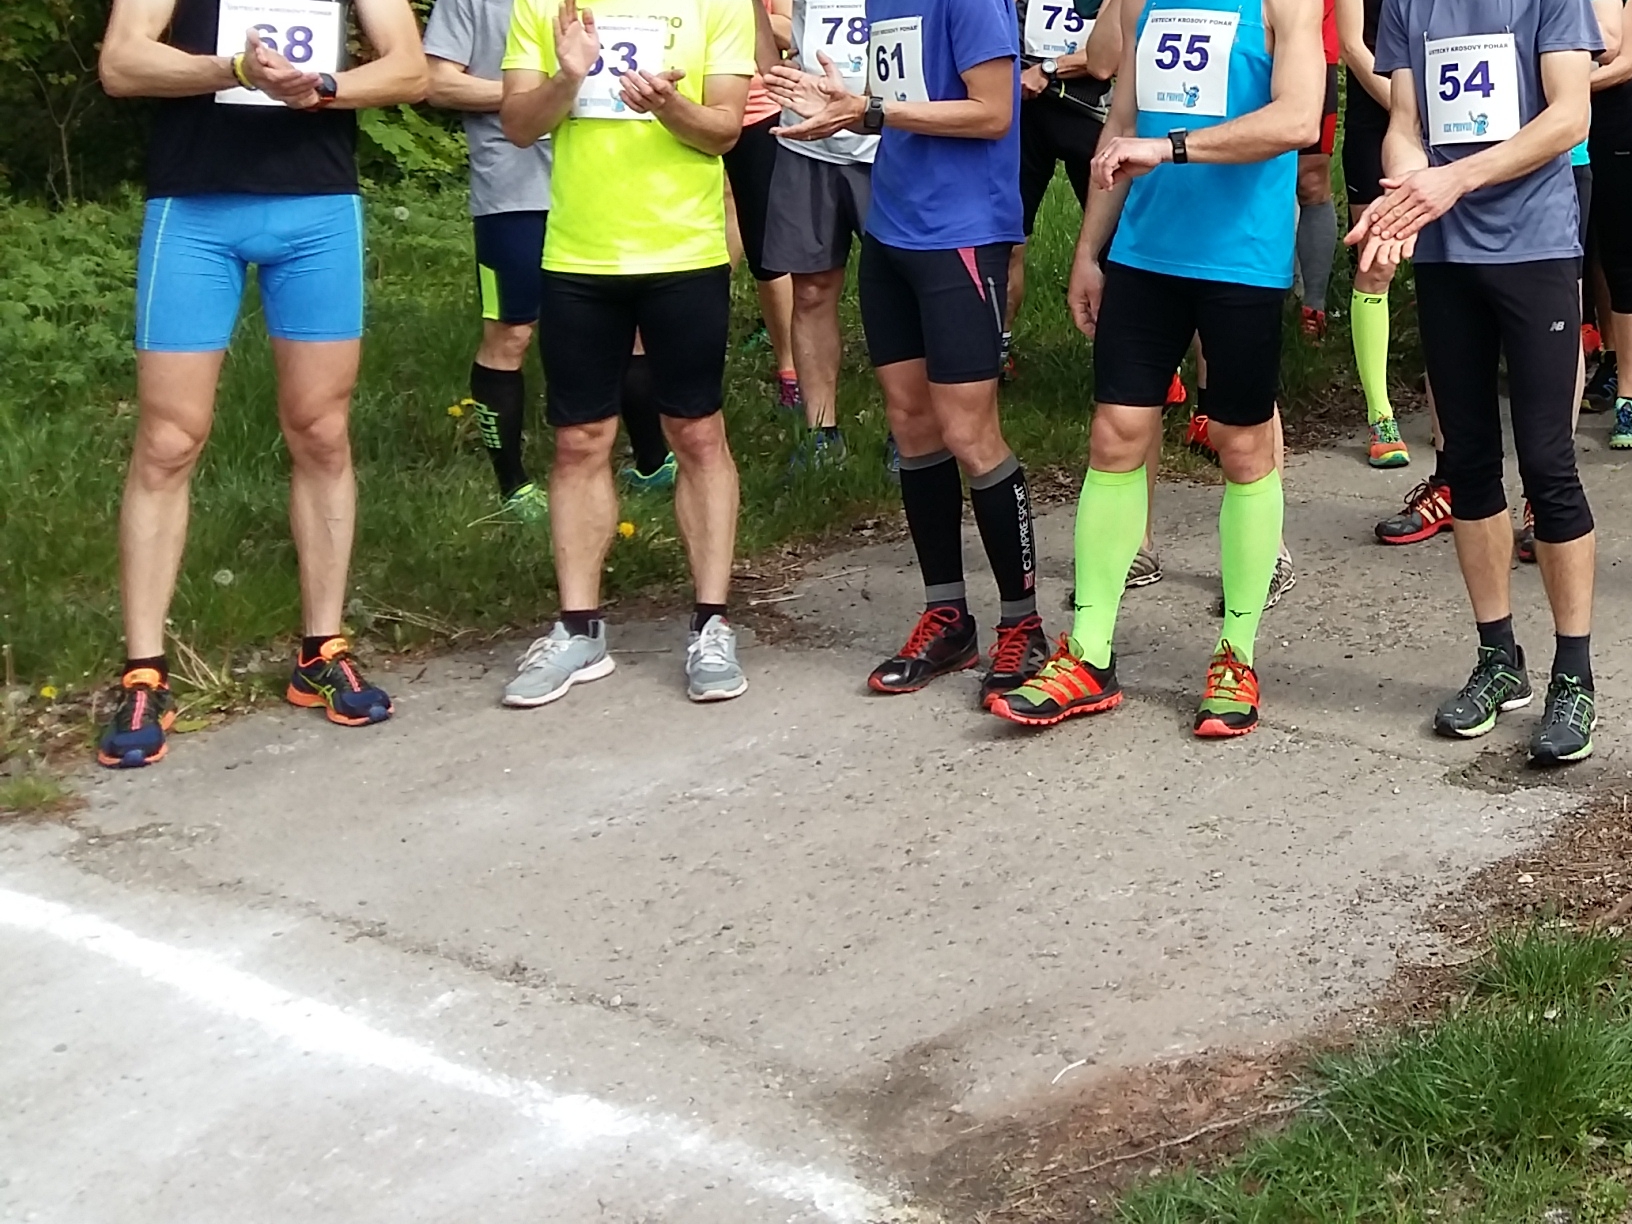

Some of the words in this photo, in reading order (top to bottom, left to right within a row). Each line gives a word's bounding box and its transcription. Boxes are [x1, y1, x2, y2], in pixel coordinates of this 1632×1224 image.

[822, 17, 869, 45] 78
[1043, 5, 1084, 32] 75
[876, 42, 905, 81] 61
[1155, 33, 1211, 71] 55
[1439, 60, 1495, 102] 54
